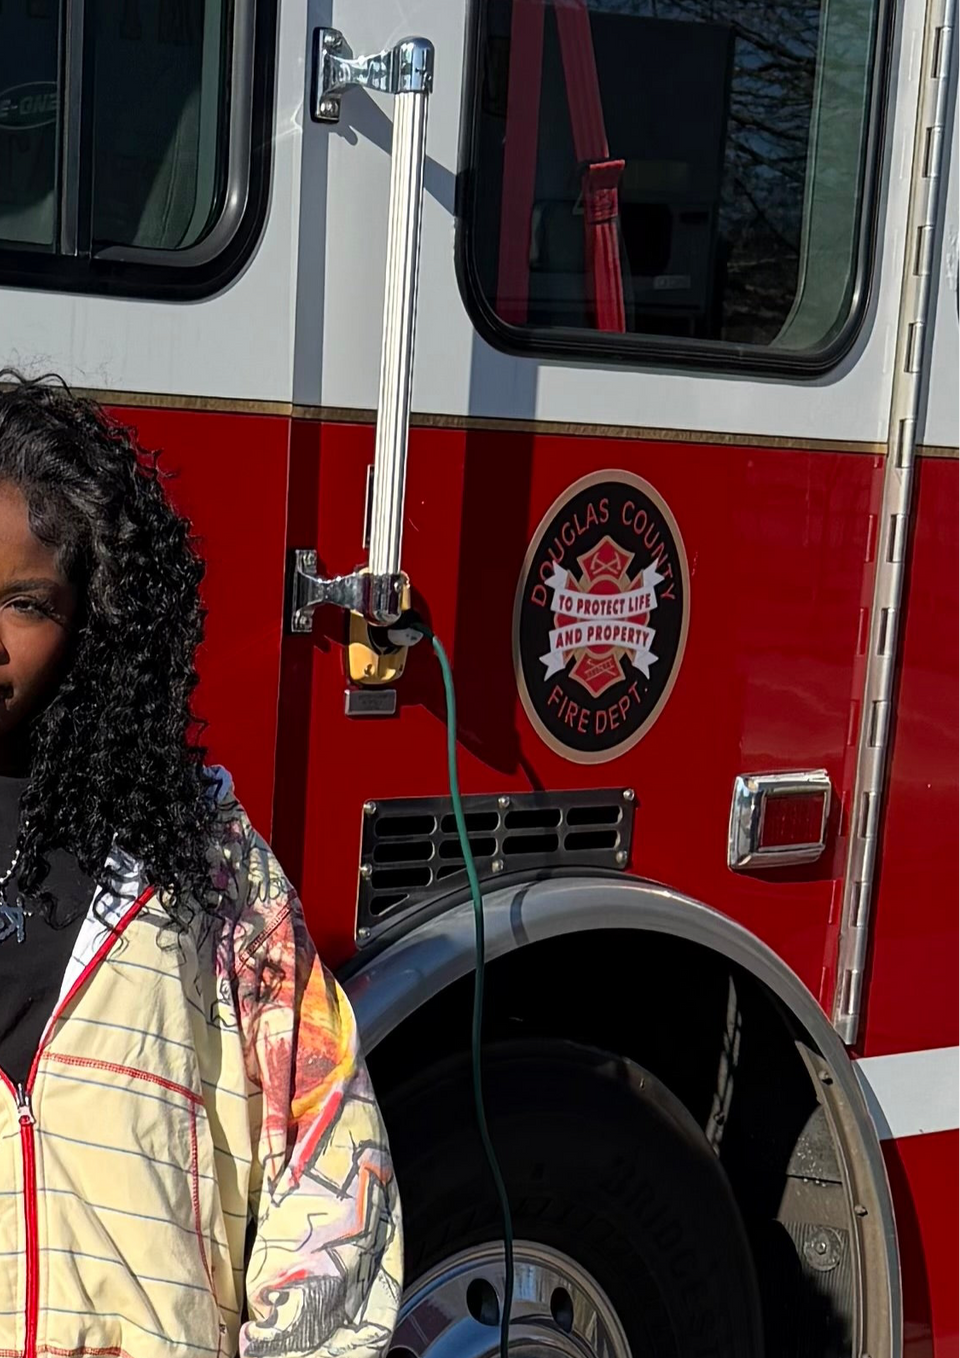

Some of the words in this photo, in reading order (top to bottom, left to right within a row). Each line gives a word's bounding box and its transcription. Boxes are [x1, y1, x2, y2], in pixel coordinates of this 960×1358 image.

[531, 497, 610, 607] DOUGLAS
[621, 500, 676, 601] COUNTY
[559, 595, 573, 612] TO
[577, 597, 626, 615] PROTECT
[628, 592, 651, 612] LIFE
[555, 629, 582, 649] AND
[587, 625, 650, 647] PROPERTY
[547, 684, 590, 734] FIRE
[596, 681, 648, 736] DEPT.
